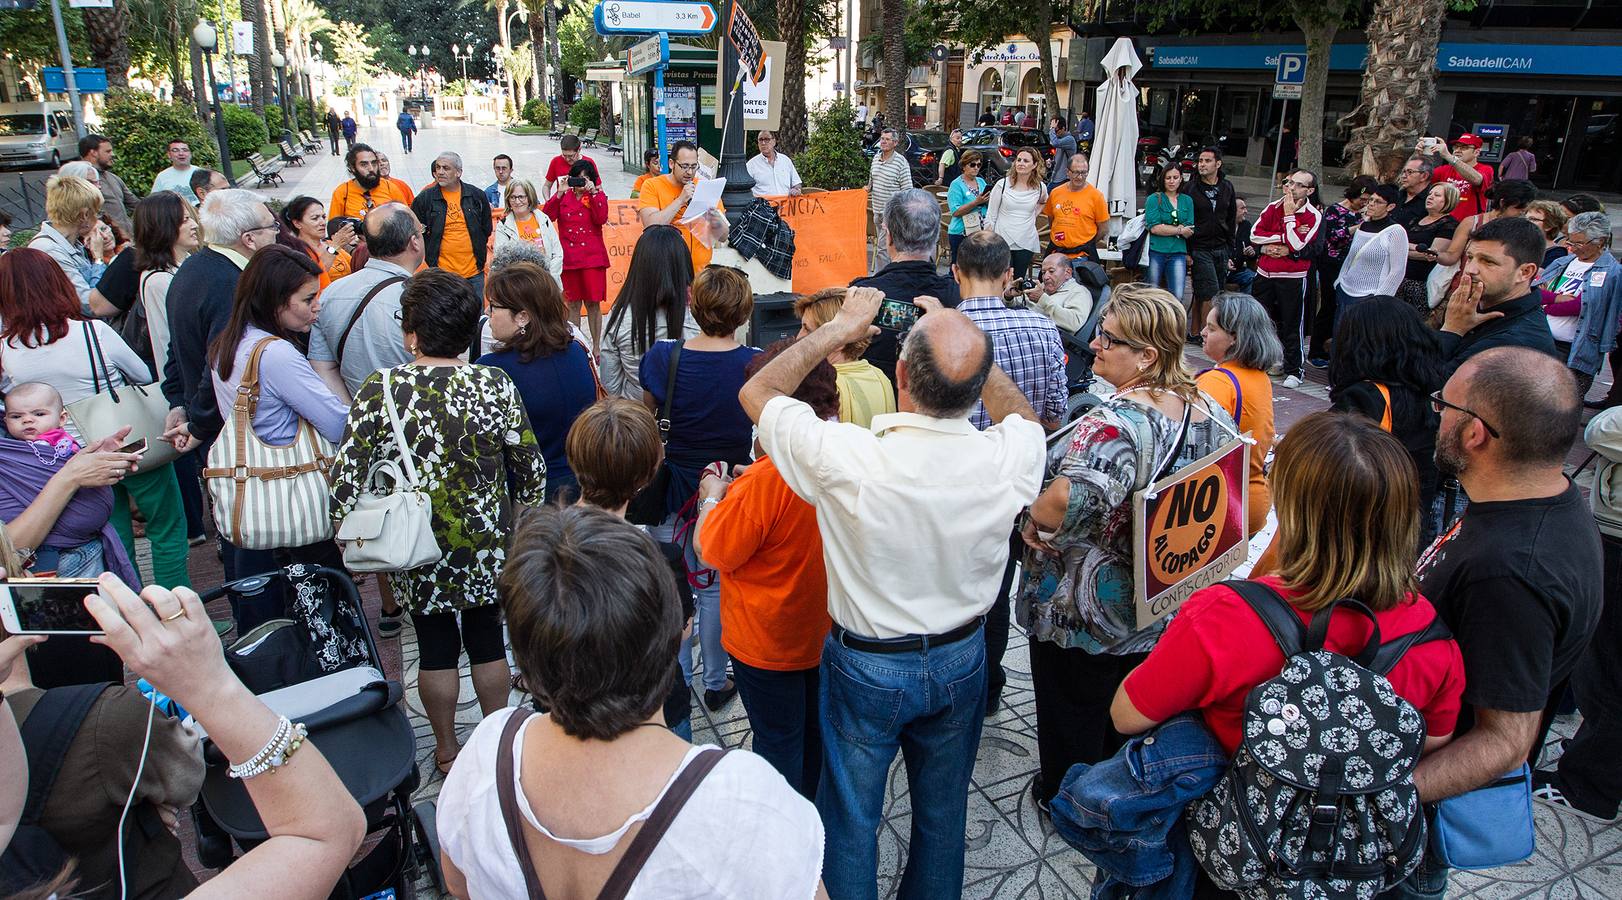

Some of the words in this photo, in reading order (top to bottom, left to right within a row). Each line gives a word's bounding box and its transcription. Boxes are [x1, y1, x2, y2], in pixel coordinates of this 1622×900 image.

[621, 11, 641, 19] Babel
[675, 12, 686, 20] 3.3
[1158, 56, 1198, 65] SabadellCAM
[1284, 57, 1301, 80] P
[1447, 56, 1533, 69] SabadellCAM
[769, 198, 825, 217] ENCIA
[1164, 475, 1220, 530] NO
[1154, 533, 1169, 562] AL
[1161, 523, 1216, 575] COPAGO
[1151, 547, 1241, 616] CONFISCATORIO
